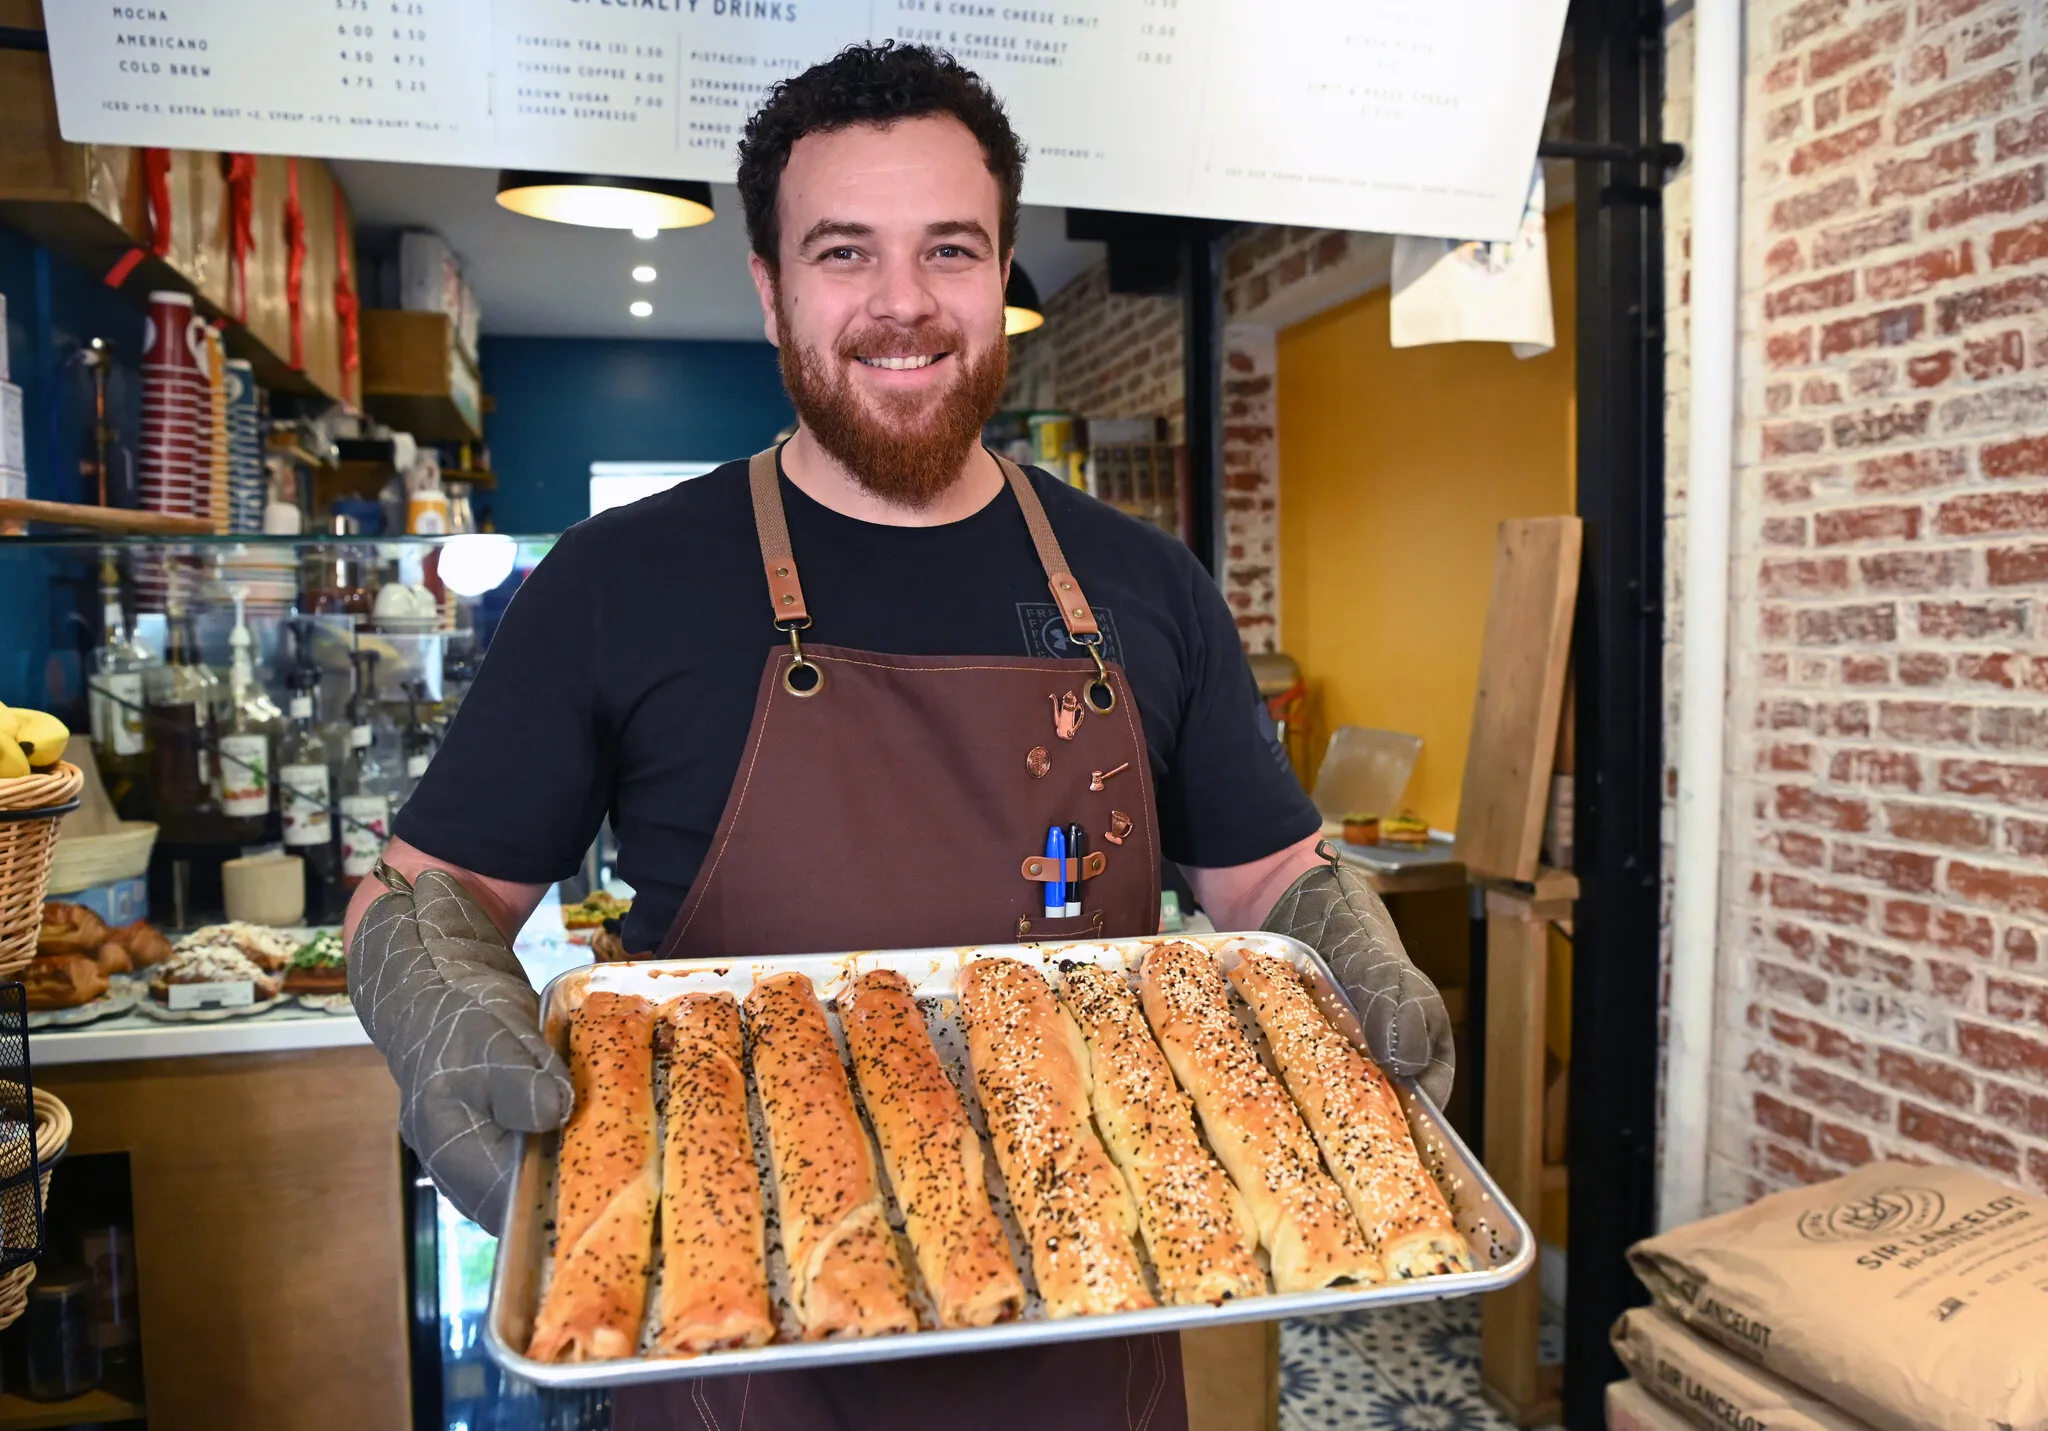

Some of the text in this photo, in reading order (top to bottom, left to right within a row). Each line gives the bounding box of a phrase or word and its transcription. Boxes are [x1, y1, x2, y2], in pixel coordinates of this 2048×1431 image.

[112, 6, 168, 22] MOCHA
[569, 0, 798, 22] IALTY DRINKS
[949, 3, 996, 19] CREAM
[1002, 7, 1055, 26] CHEESE
[1063, 15, 1099, 28] SIMIT
[116, 33, 209, 51] AMERICANO
[577, 40, 602, 52] TEA
[964, 33, 1017, 50] CHEESE
[1025, 39, 1069, 54] TOAST
[118, 59, 161, 75] COLD
[169, 62, 211, 78] BREW
[690, 51, 800, 71] PISTACHIO LATTE
[577, 66, 626, 80] COFFEE
[691, 78, 763, 93] STRAWBERR
[568, 91, 610, 104] SUGAR
[690, 95, 739, 107] MATCHA
[101, 100, 130, 112] ICED
[169, 104, 207, 116] EXTRA
[573, 107, 637, 122] ESPRESSO
[689, 121, 733, 134] MANGO
[689, 138, 726, 150] LATTE
[1856, 1243, 1908, 1270] SIR
[1903, 1195, 2026, 1247] LANCELOT
[1658, 1359, 1683, 1390] SIR
